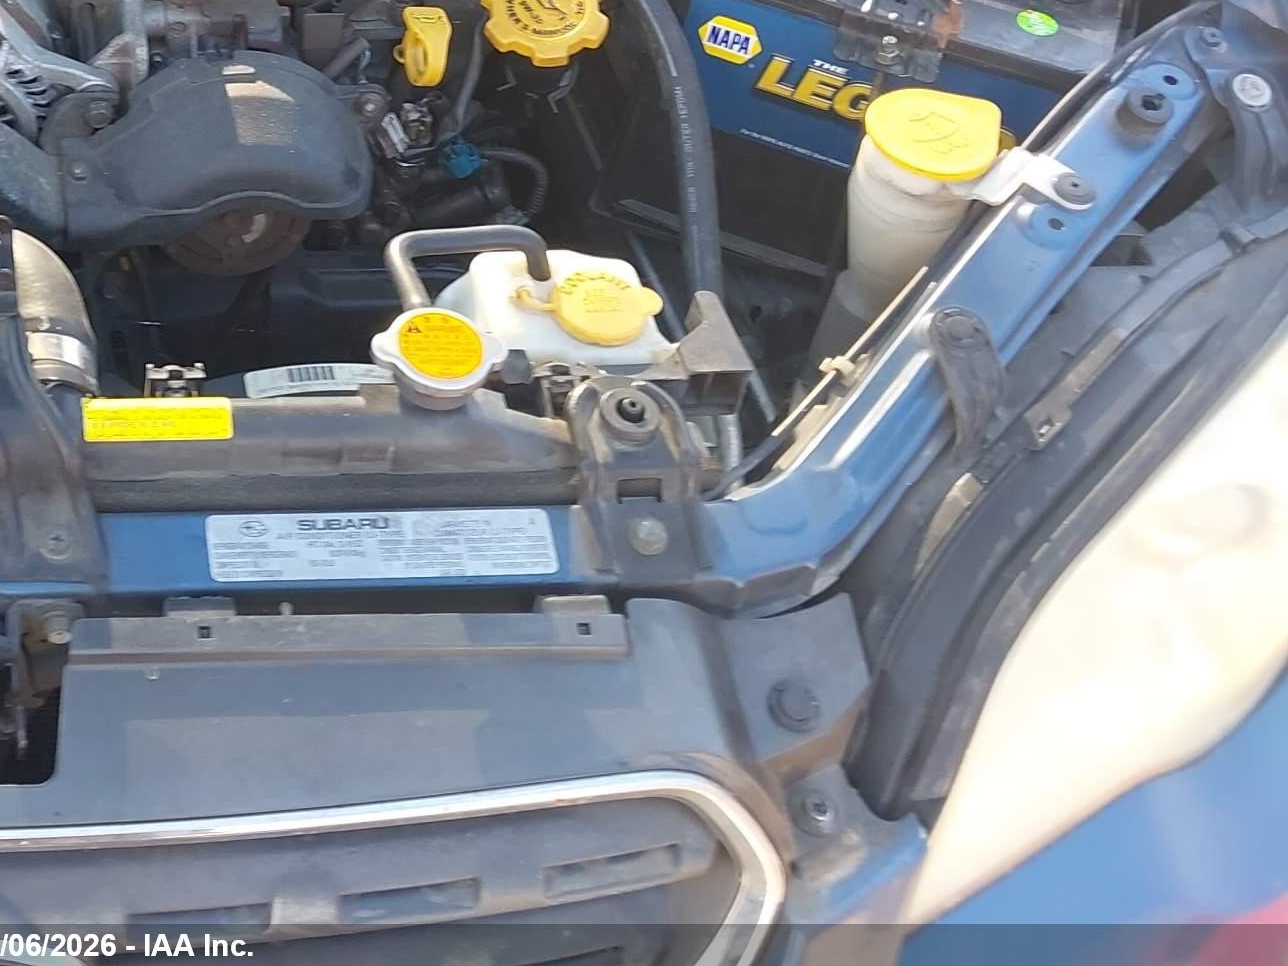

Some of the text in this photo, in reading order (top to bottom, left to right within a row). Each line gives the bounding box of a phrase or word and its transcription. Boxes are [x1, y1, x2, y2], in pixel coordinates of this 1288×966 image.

[706, 24, 752, 56] NAPA
[812, 58, 849, 76] THE
[754, 52, 874, 123] LEG
[296, 517, 390, 533] SUBARU
